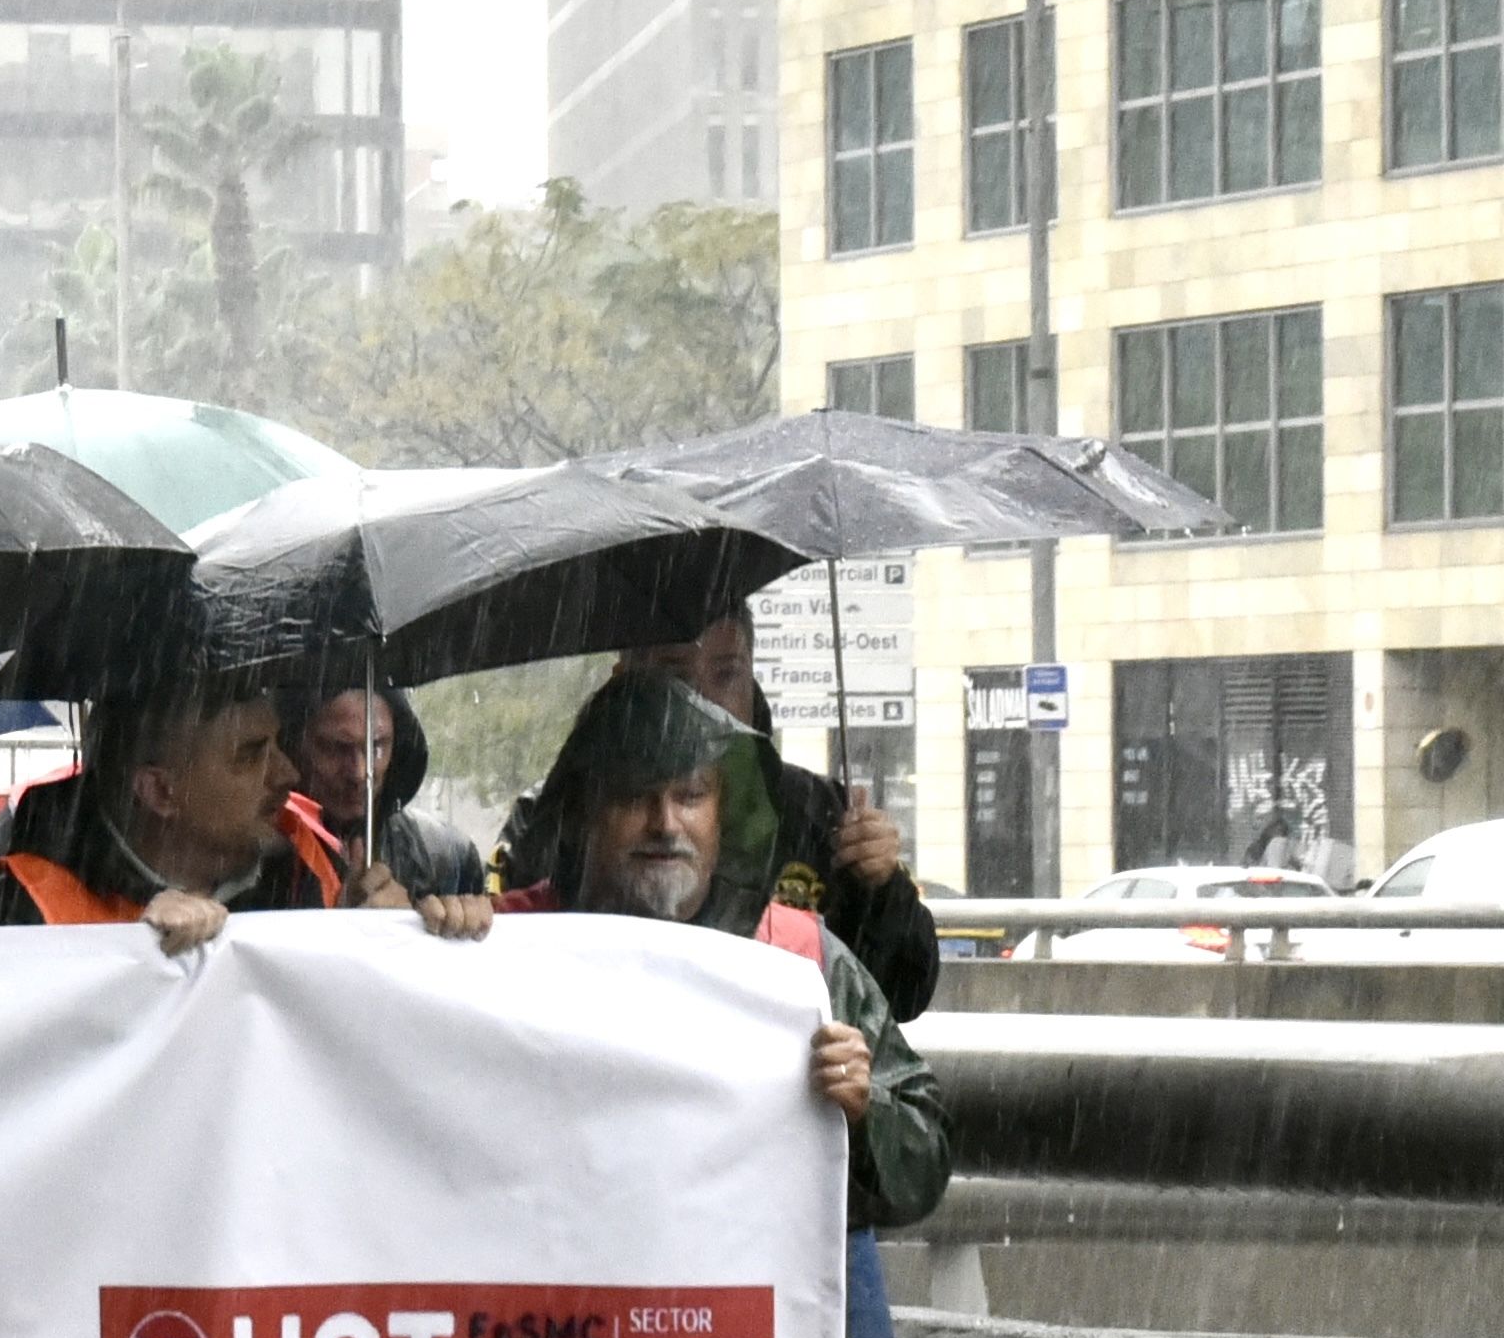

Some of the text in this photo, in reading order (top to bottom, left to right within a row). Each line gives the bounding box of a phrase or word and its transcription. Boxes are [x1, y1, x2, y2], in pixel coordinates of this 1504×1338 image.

[788, 566, 878, 581] Comrcial
[760, 599, 802, 615] Gran
[771, 667, 833, 683] Franca
[629, 1307, 713, 1333] SECTOR
